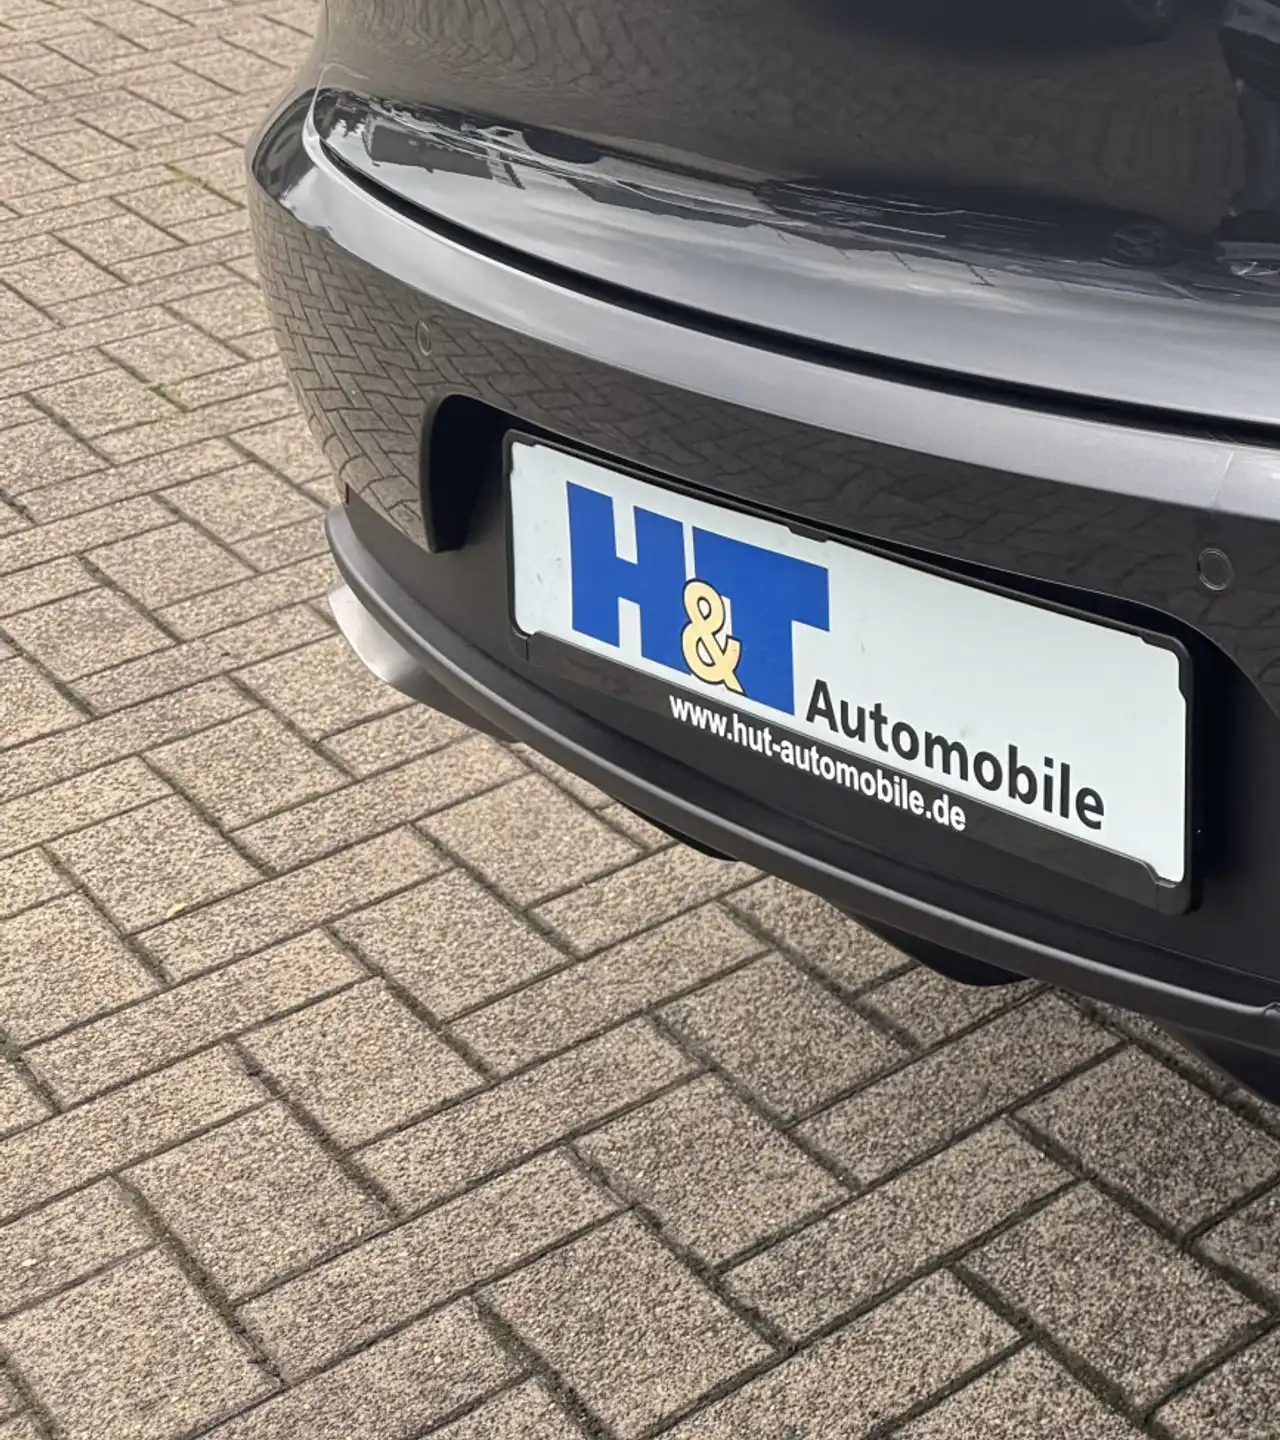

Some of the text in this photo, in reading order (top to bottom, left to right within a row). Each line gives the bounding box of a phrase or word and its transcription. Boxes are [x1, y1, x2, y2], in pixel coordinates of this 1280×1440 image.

[566, 481, 1105, 830] H&T Automobile
[669, 693, 967, 832] www.hut-automobile.de
